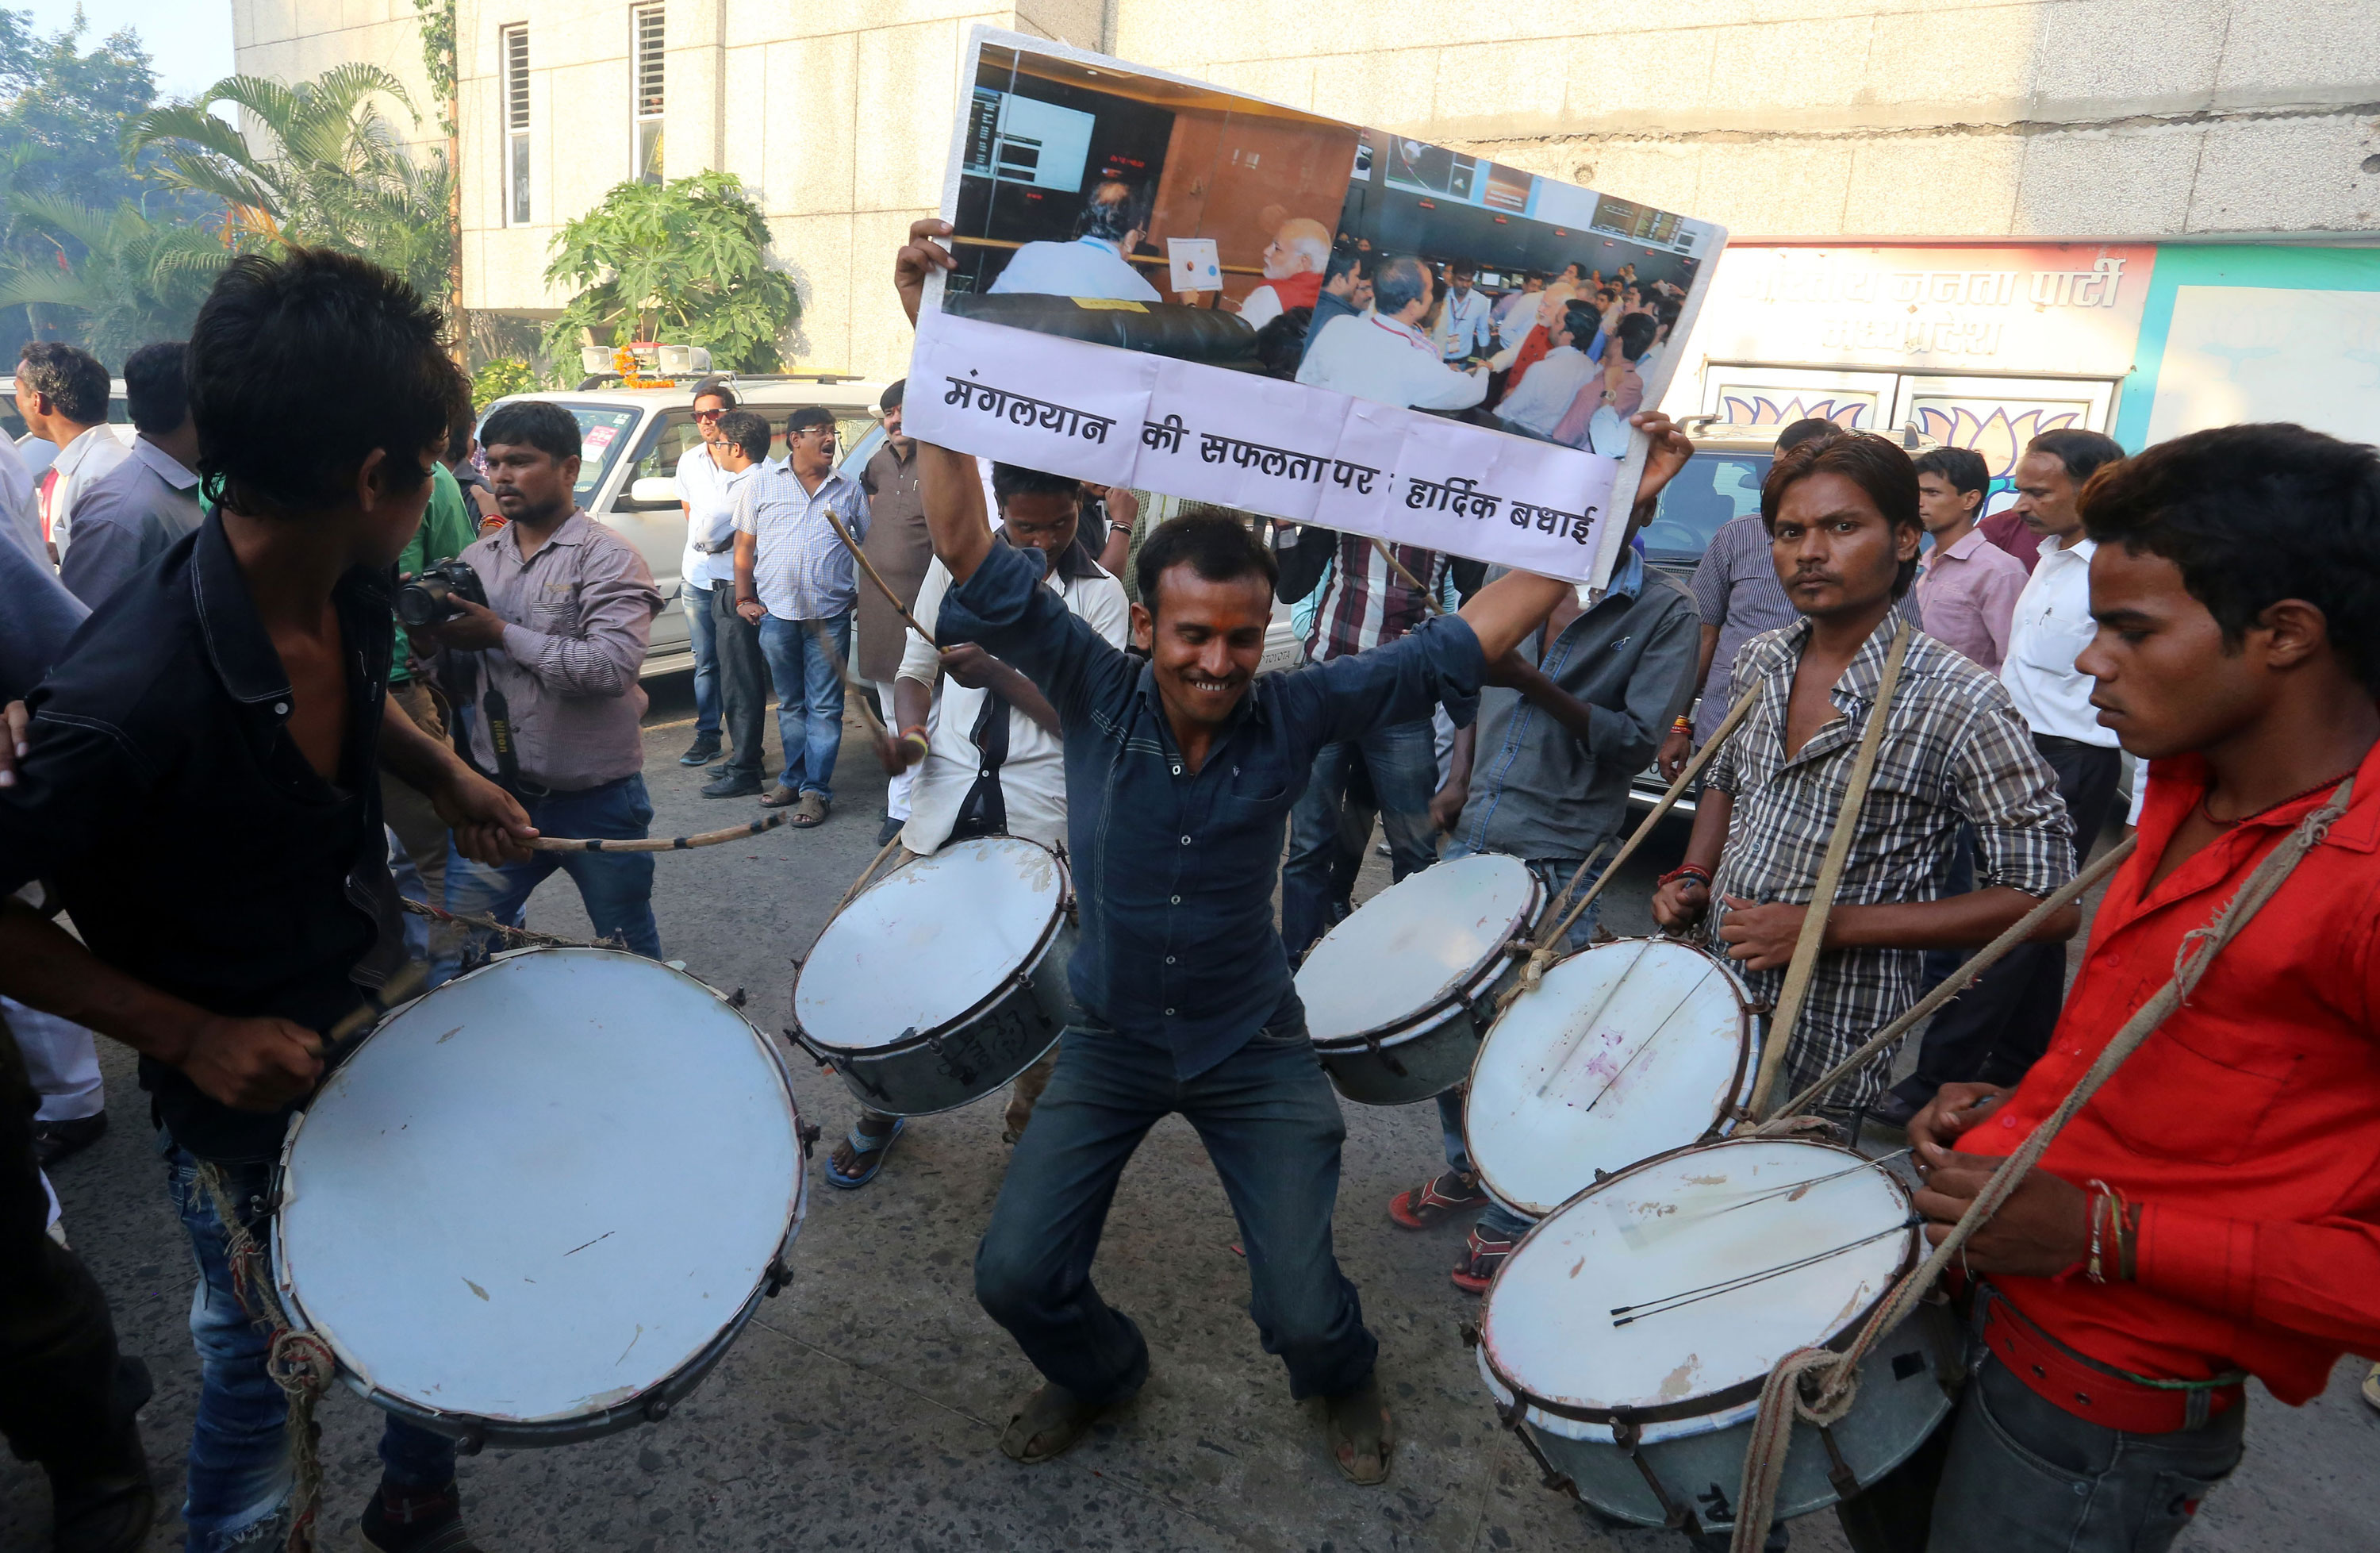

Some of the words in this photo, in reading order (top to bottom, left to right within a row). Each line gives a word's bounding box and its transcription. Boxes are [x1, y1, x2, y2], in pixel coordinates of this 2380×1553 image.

[1892, 271, 2018, 306] जनता
[2028, 257, 2126, 307] पार्टी
[944, 368, 1117, 444] मंगलयान
[1142, 414, 1189, 454] की
[1200, 432, 1331, 484] सफलता
[1333, 459, 1380, 494] पर
[1405, 477, 1502, 520] हार्दिक
[1510, 501, 1598, 545] बधाई
[1265, 651, 1290, 663] TOYOTA
[493, 721, 508, 752] Nikon
